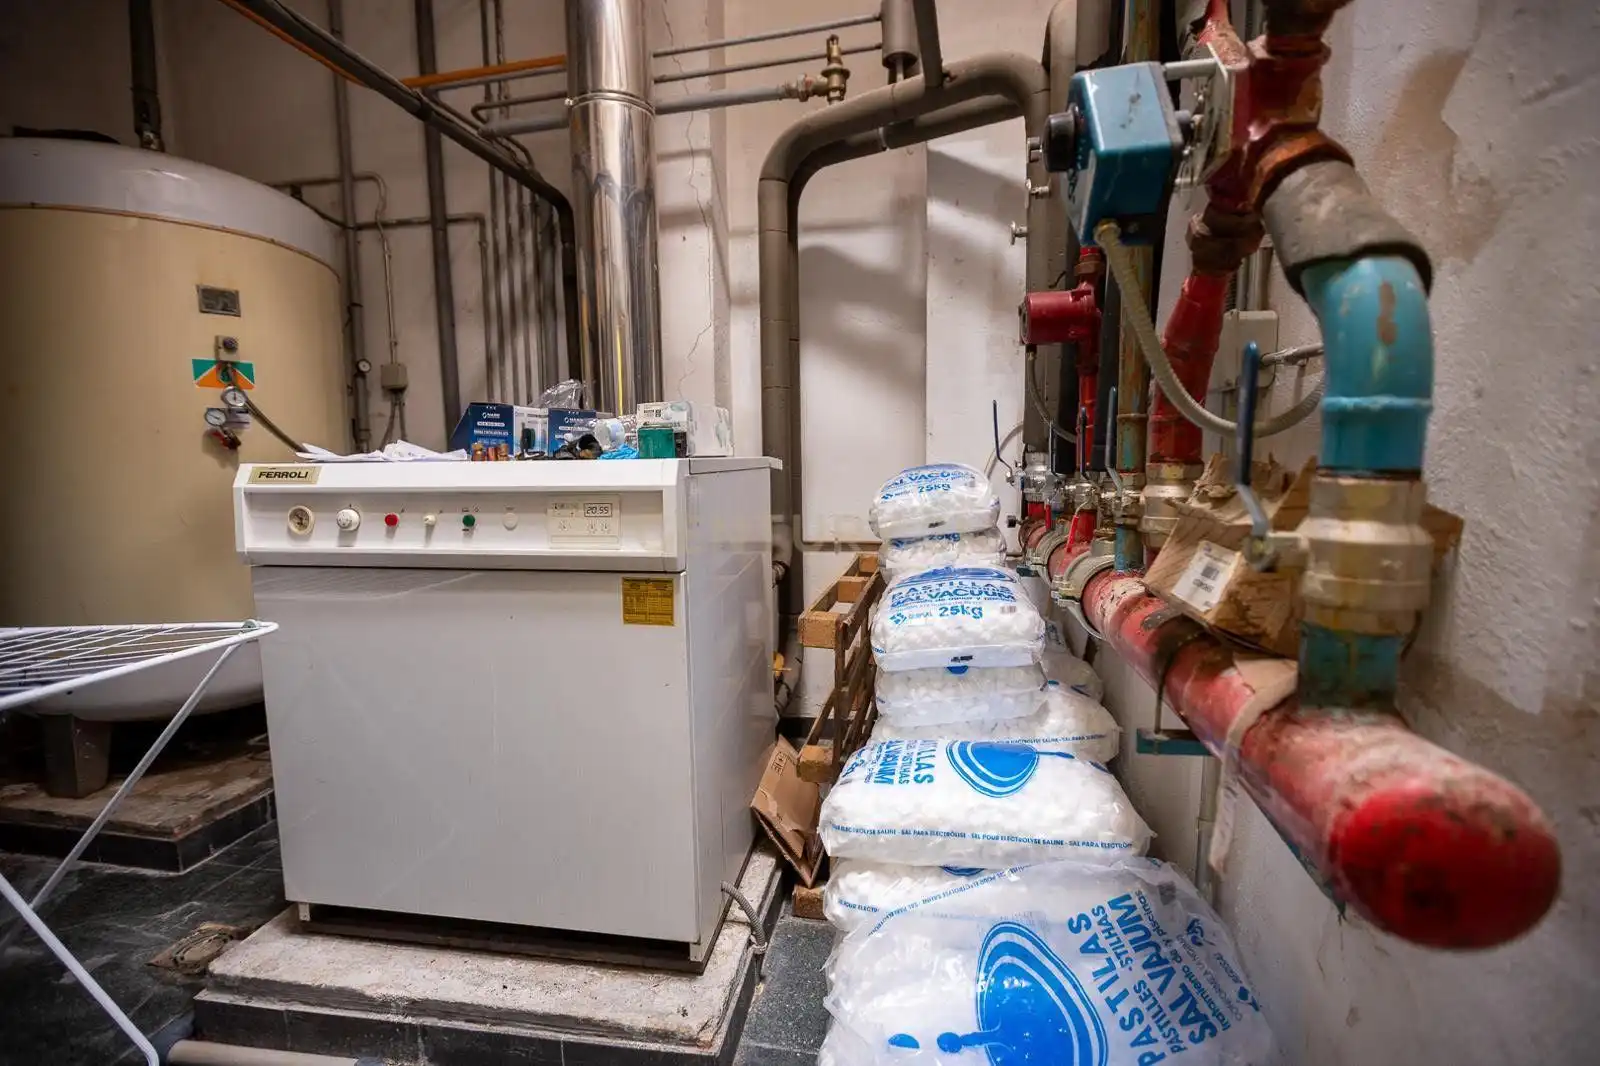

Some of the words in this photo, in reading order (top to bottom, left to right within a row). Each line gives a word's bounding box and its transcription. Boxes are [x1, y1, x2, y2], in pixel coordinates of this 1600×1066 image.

[258, 471, 308, 479] FERROLI
[918, 483, 952, 493] 25kg
[938, 605, 983, 619] 25kg
[1042, 838, 1064, 846] SALINE
[1134, 890, 1168, 938] piscinas
[1169, 982, 1218, 1045] SAL
